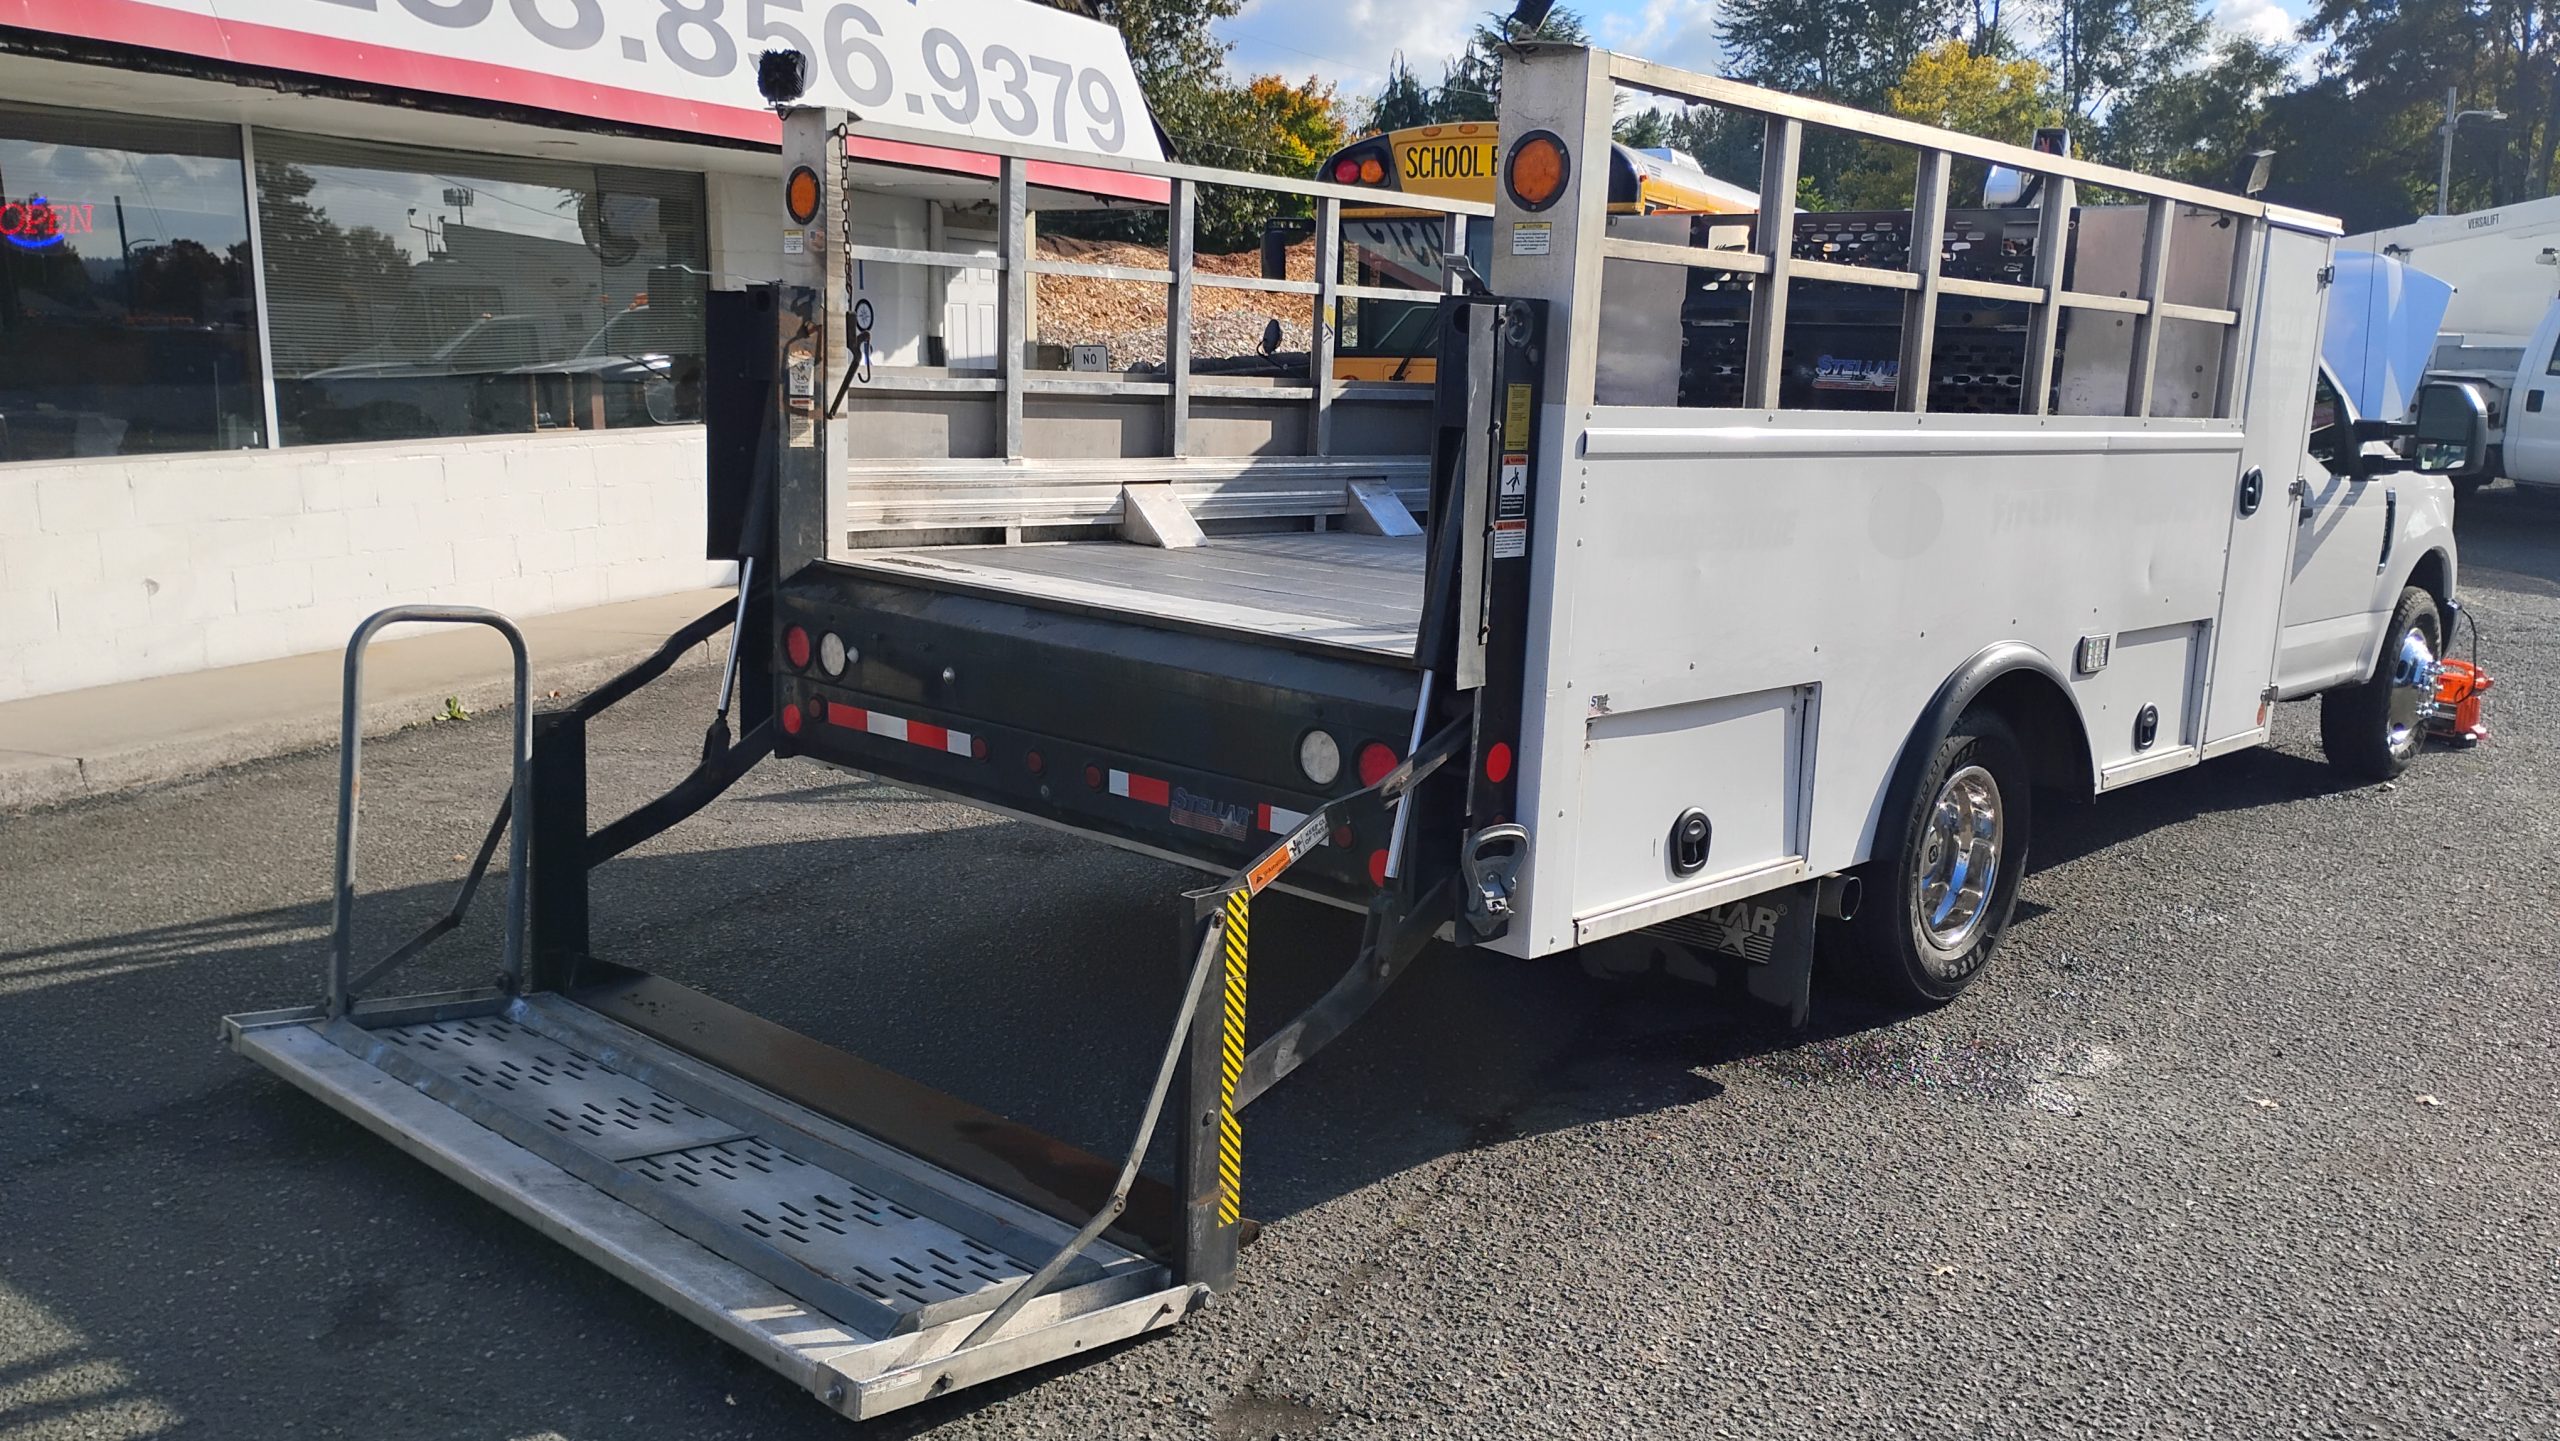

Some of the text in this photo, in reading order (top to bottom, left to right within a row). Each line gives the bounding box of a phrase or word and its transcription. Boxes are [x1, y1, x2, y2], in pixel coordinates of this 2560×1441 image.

[316, 0, 1126, 154] .856.9379
[1405, 145, 1484, 178] SCHOOL
[0, 203, 95, 235] OPEN
[2467, 213, 2500, 230] VERSALIFT
[1083, 353, 1097, 365] NO
[1171, 786, 1250, 827] STELLAR
